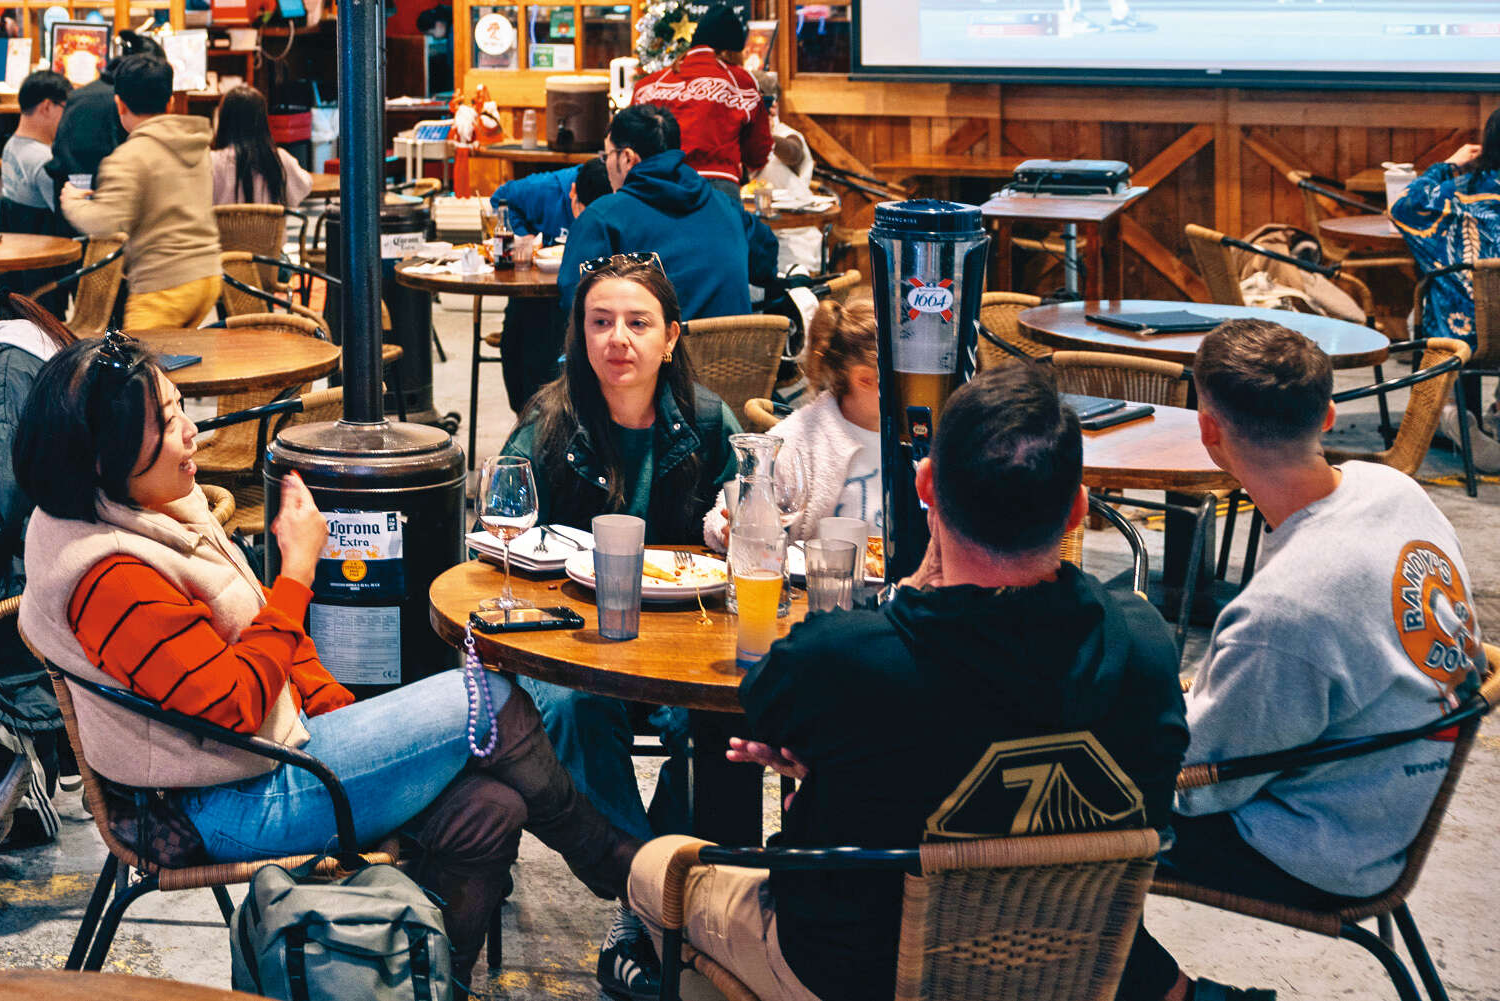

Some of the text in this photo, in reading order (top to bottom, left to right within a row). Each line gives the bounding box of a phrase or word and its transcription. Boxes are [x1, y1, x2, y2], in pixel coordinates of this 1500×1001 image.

[327, 520, 381, 539] Corona
[340, 536, 370, 547] Extra
[1401, 548, 1452, 632] RANDY'S
